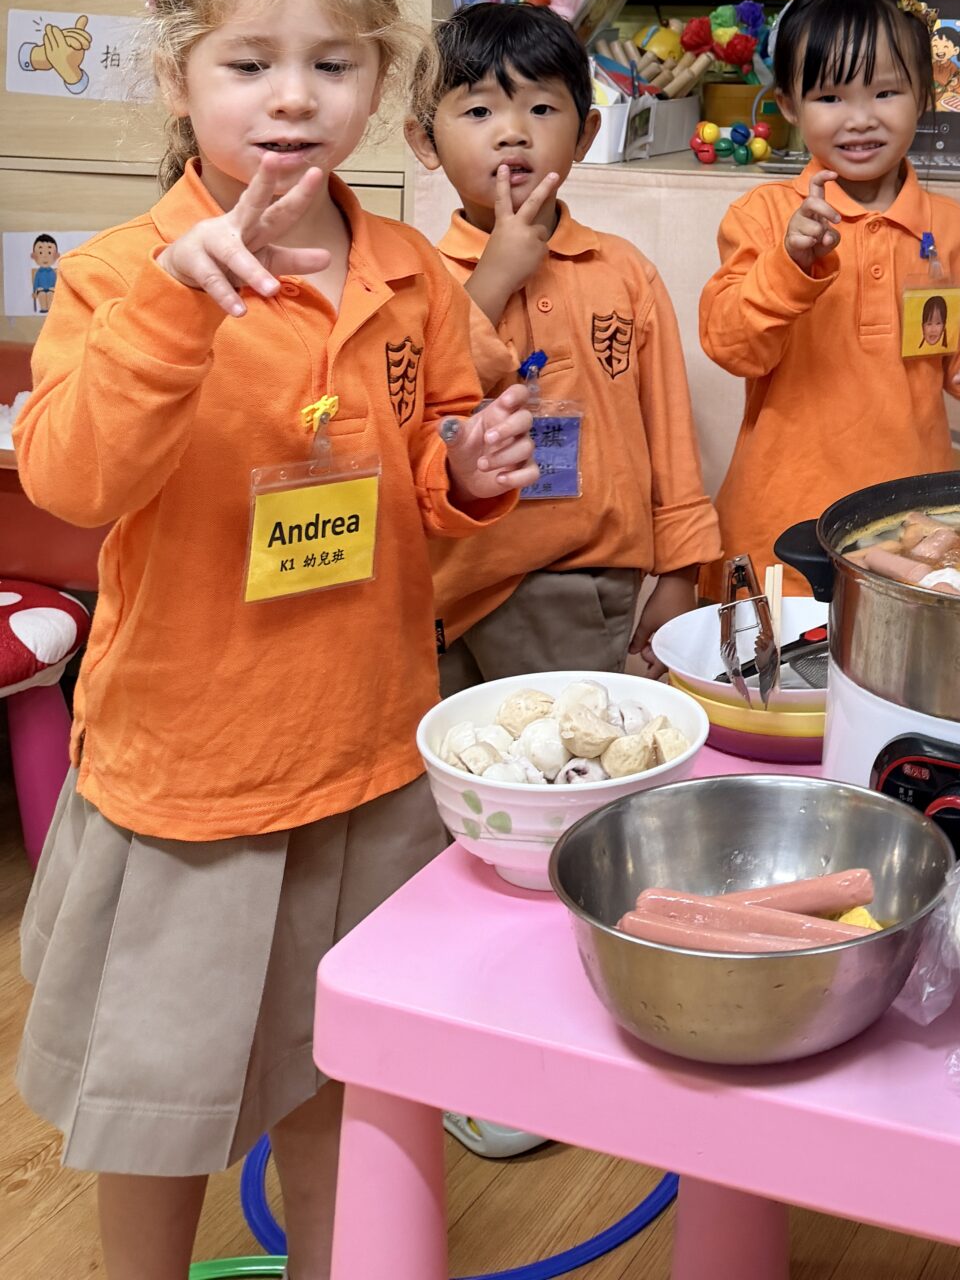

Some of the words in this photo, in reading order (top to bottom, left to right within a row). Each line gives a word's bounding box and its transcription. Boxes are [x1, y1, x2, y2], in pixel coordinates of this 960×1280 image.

[267, 513, 360, 549] Andrea
[280, 558, 295, 572] K1
[303, 549, 345, 568] 幼兒班
